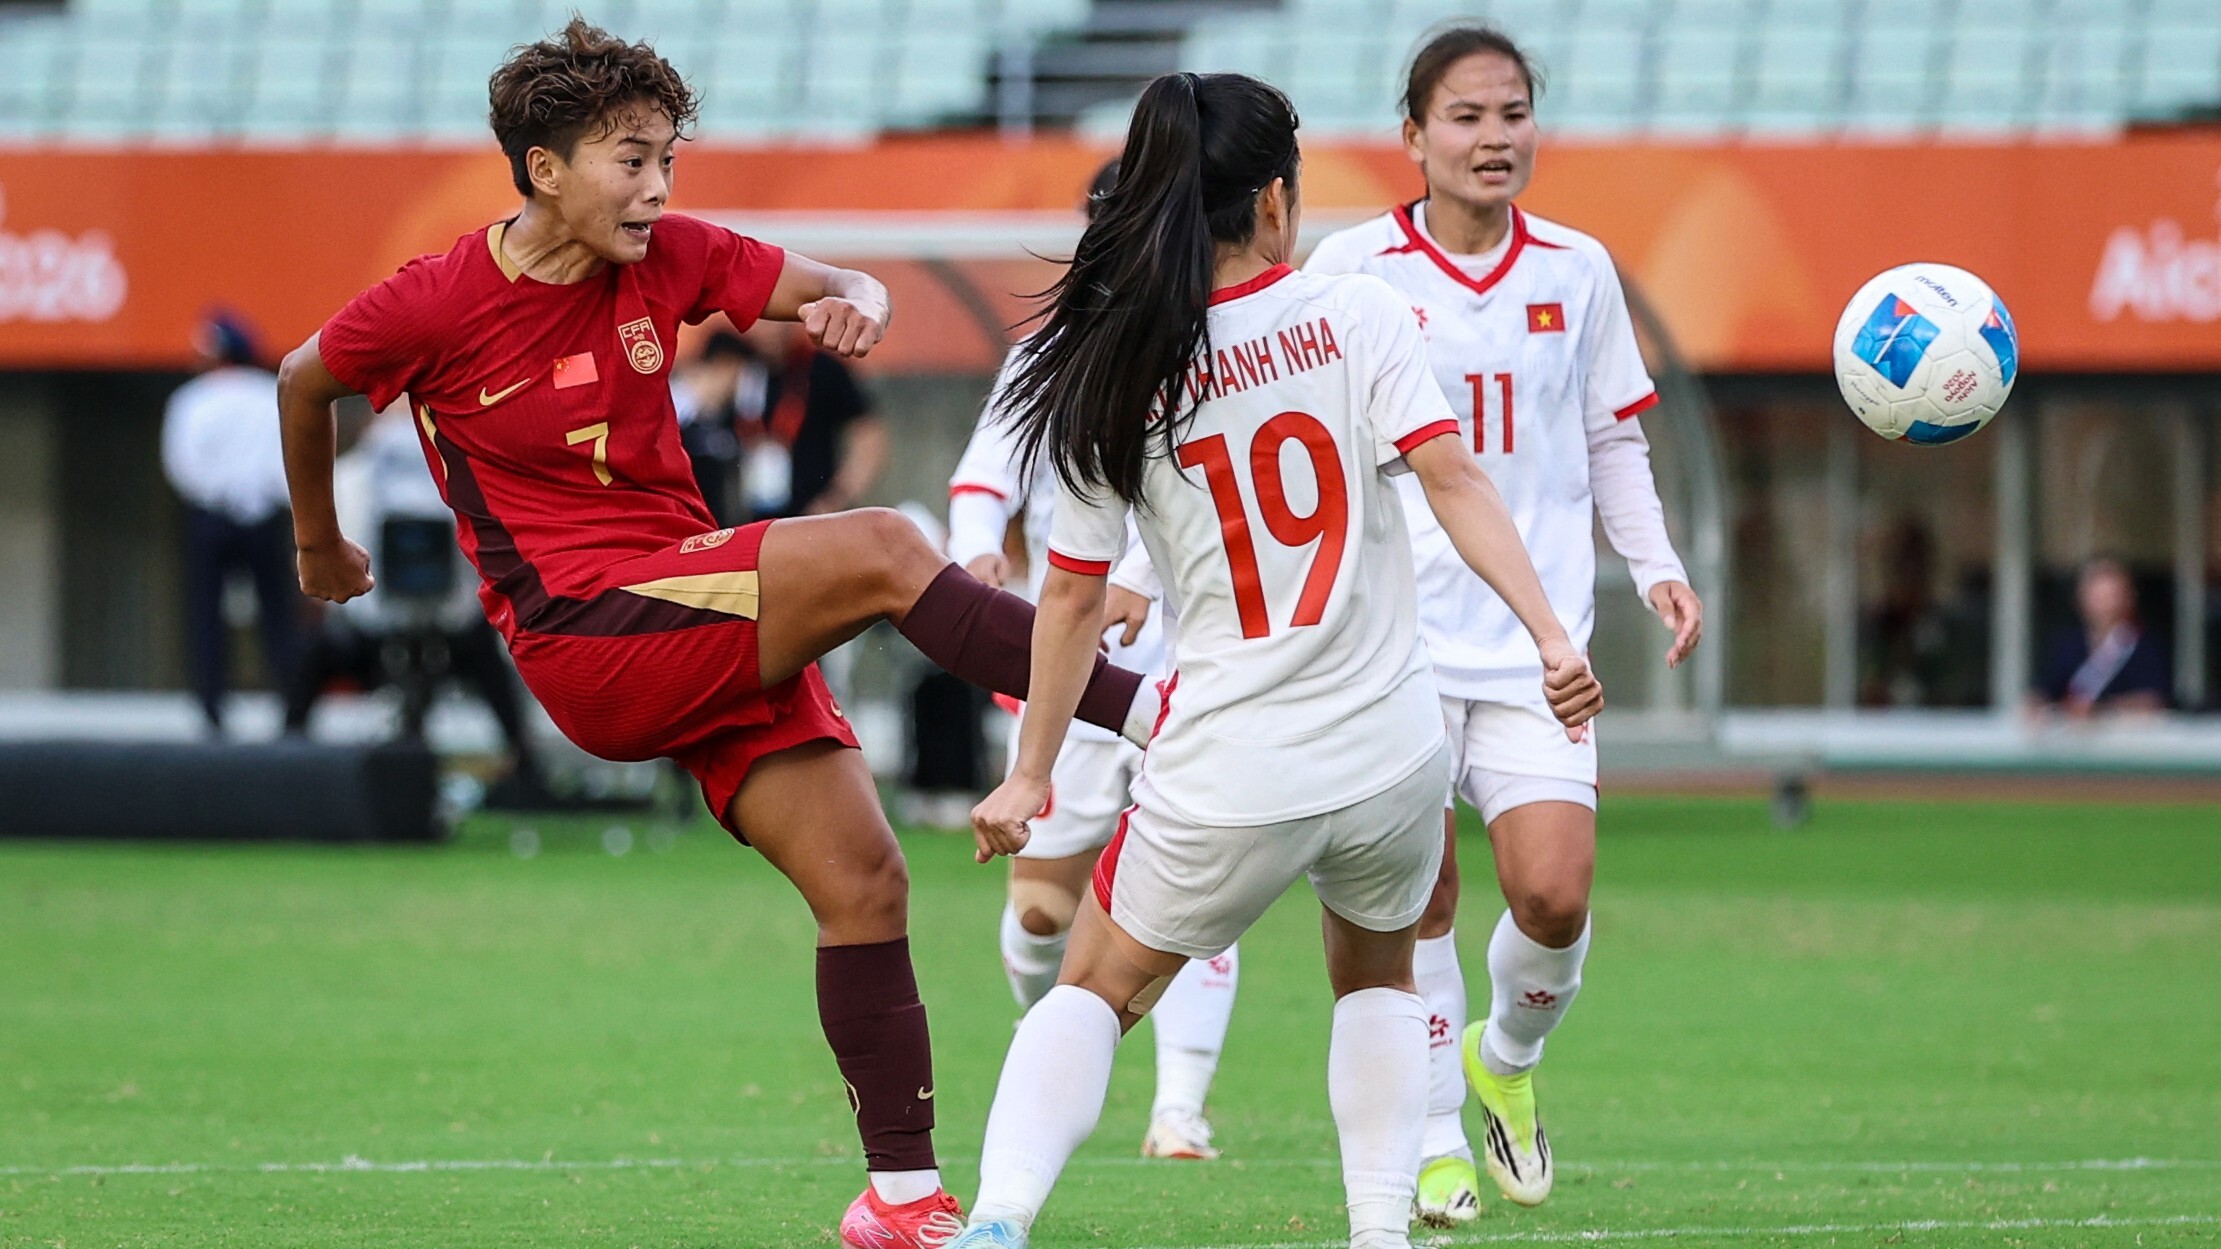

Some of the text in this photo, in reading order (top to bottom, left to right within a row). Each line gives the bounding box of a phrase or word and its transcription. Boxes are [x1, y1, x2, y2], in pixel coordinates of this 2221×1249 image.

[1914, 275, 1959, 307] molten
[622, 321, 650, 338] CFA
[1278, 317, 1342, 376] NHA
[1464, 373, 1514, 454] 11
[565, 421, 613, 487] 7
[1176, 411, 1348, 640] 19
